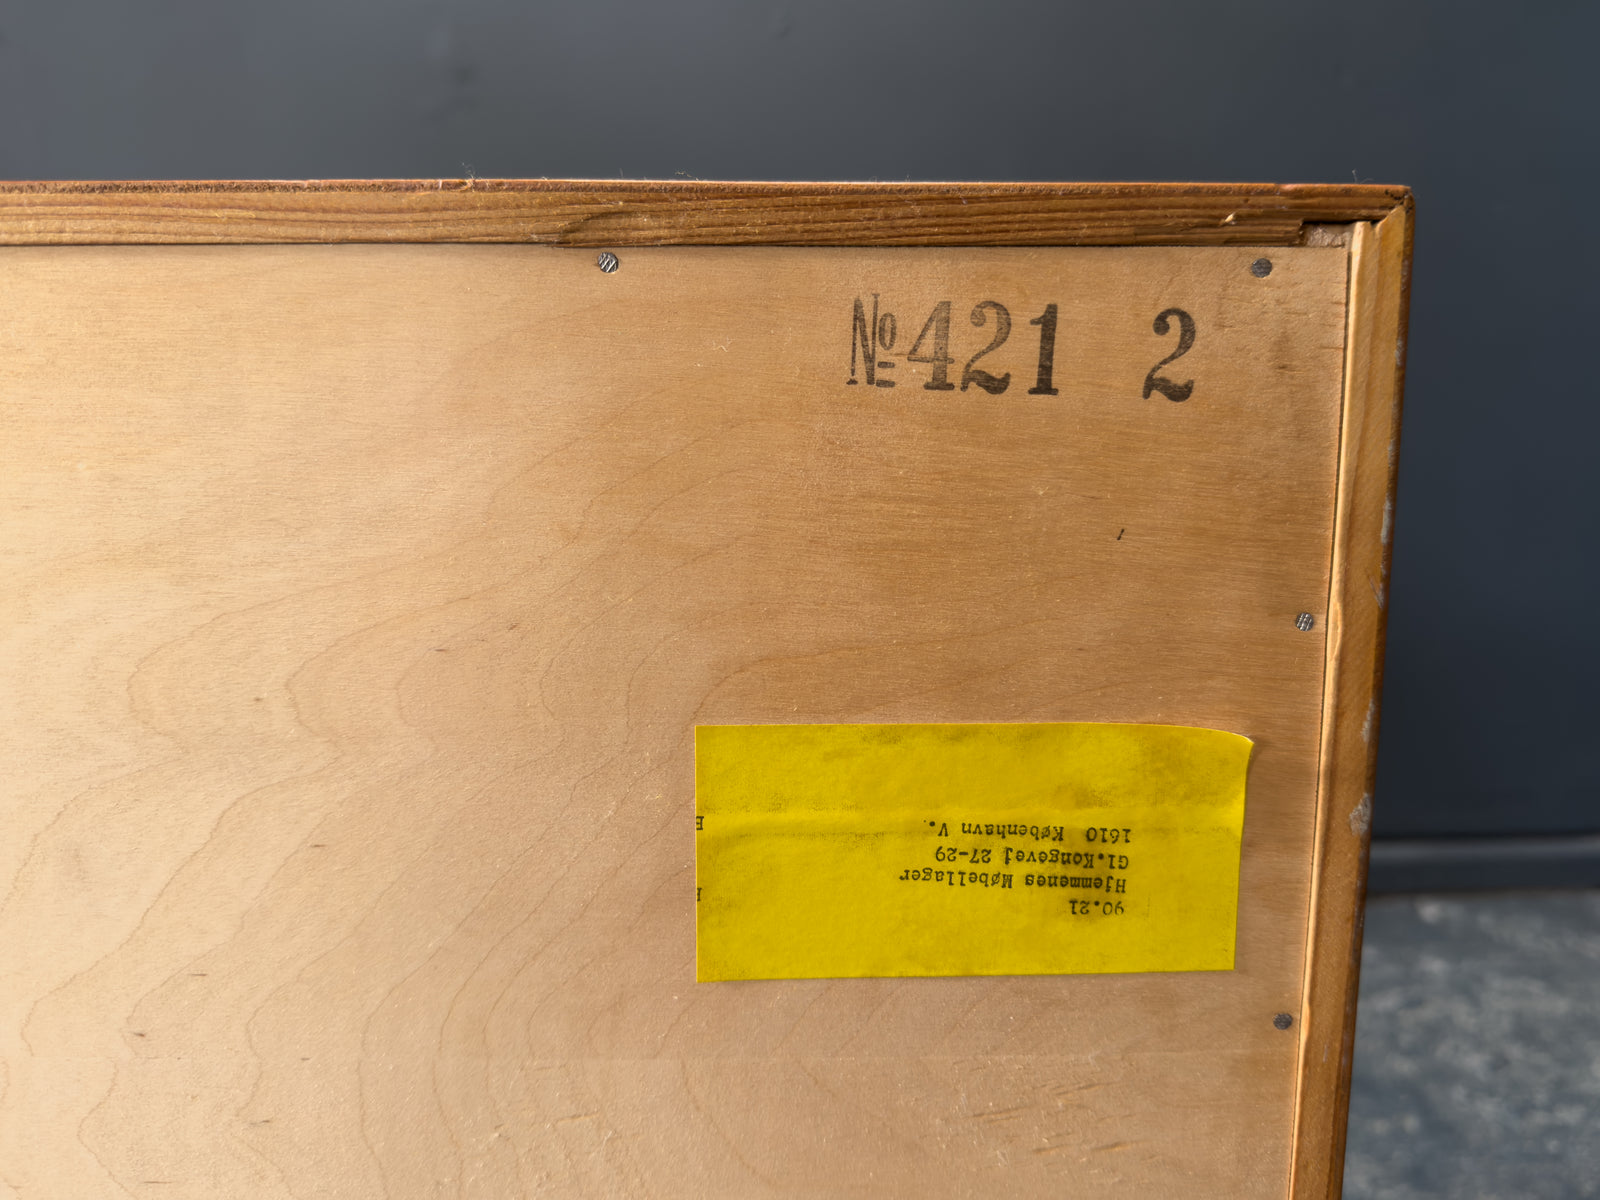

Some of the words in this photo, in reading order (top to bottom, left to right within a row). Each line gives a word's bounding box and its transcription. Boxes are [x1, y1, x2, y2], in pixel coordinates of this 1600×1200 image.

[1143, 308, 1196, 402] 2
[961, 822, 1065, 842] København
[1085, 827, 1132, 844] 1610
[935, 846, 992, 864] 27-29
[899, 867, 1014, 889] Møbellager
[1024, 874, 1127, 894] Hjemmenes
[1068, 899, 1125, 916] 90.21
